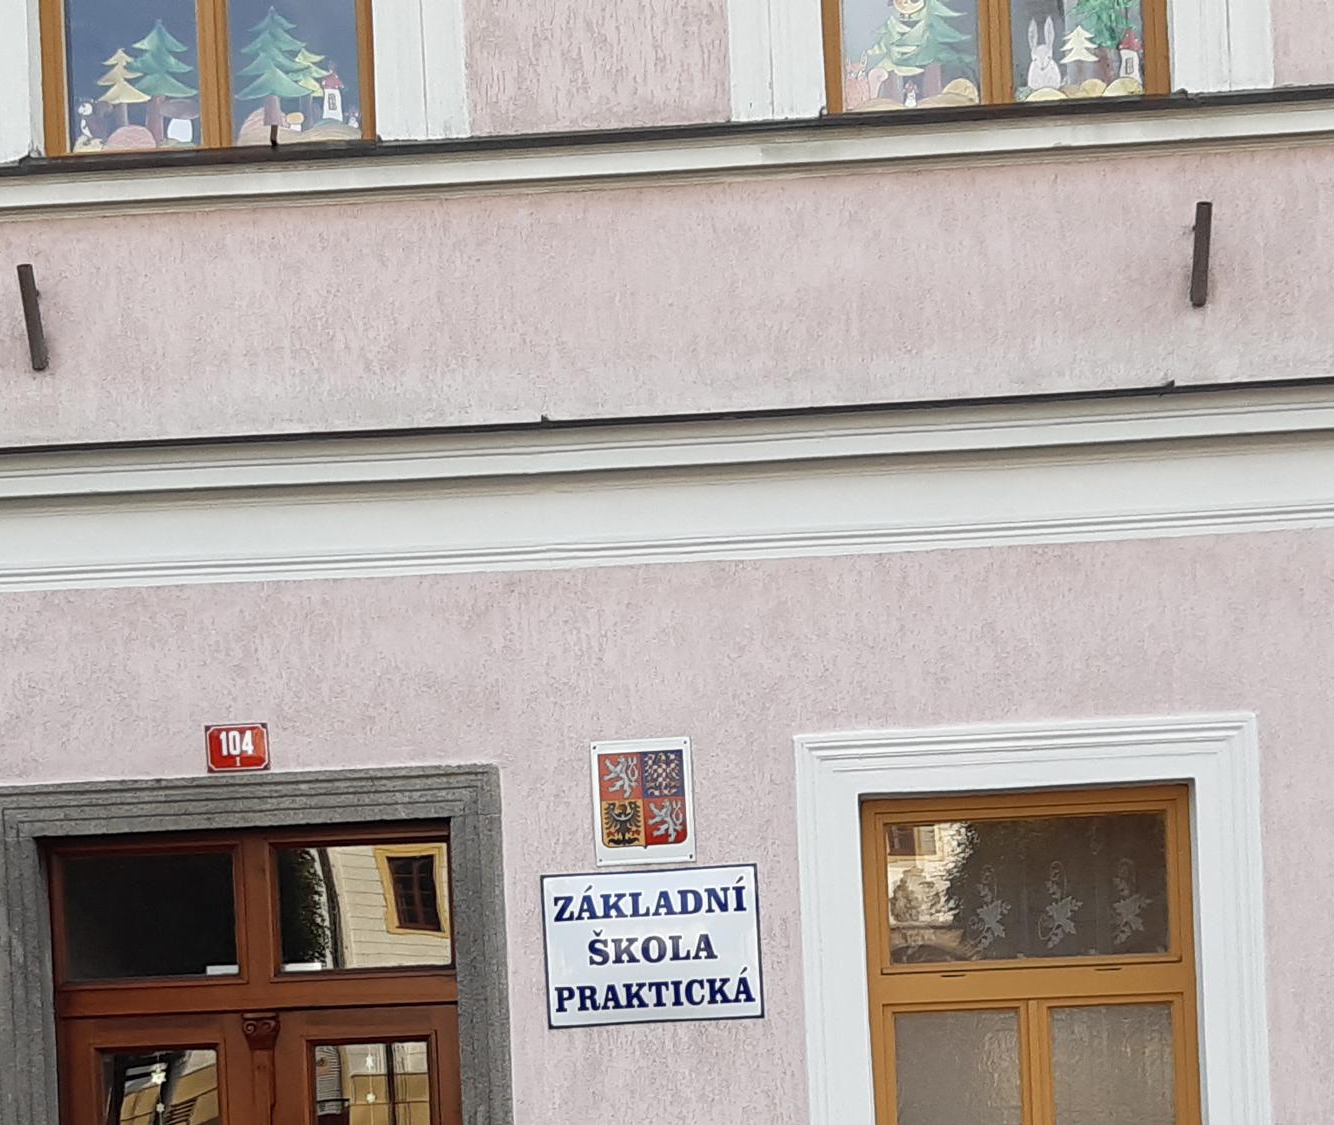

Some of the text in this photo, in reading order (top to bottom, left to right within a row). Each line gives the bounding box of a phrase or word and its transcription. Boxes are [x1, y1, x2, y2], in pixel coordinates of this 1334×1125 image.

[219, 730, 254, 756] 104
[553, 876, 747, 922] ZÁKLADNÍ
[588, 929, 718, 966] ŠKOLA
[554, 967, 756, 1012] PRAKTICKÁ
